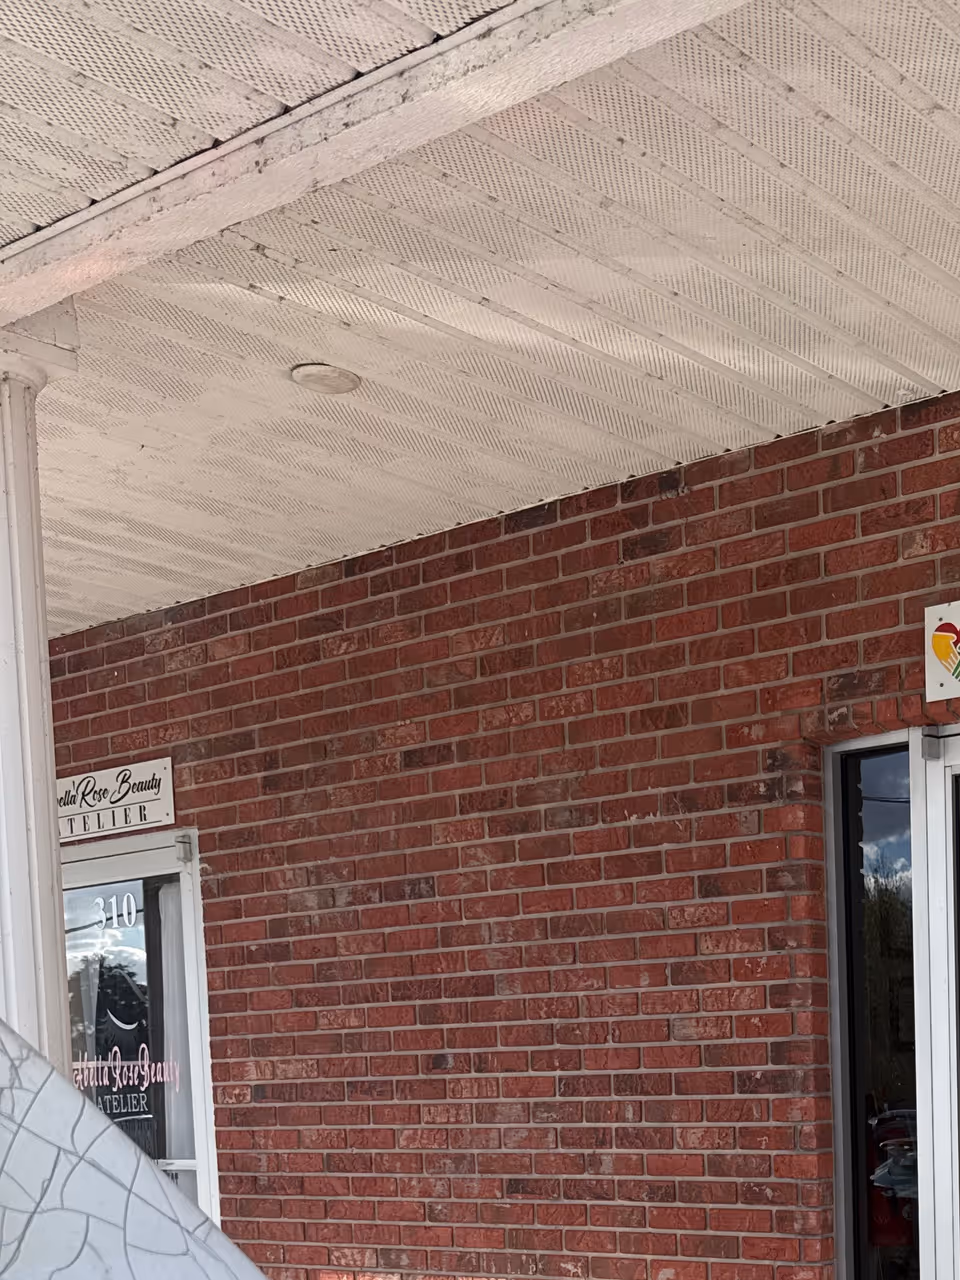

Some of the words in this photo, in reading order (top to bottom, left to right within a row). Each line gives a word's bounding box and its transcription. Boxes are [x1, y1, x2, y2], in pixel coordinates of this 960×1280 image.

[110, 769, 162, 804] Beauty
[59, 805, 147, 836] TELIER
[92, 893, 137, 930] 310
[98, 1093, 148, 1113] ATELIER
